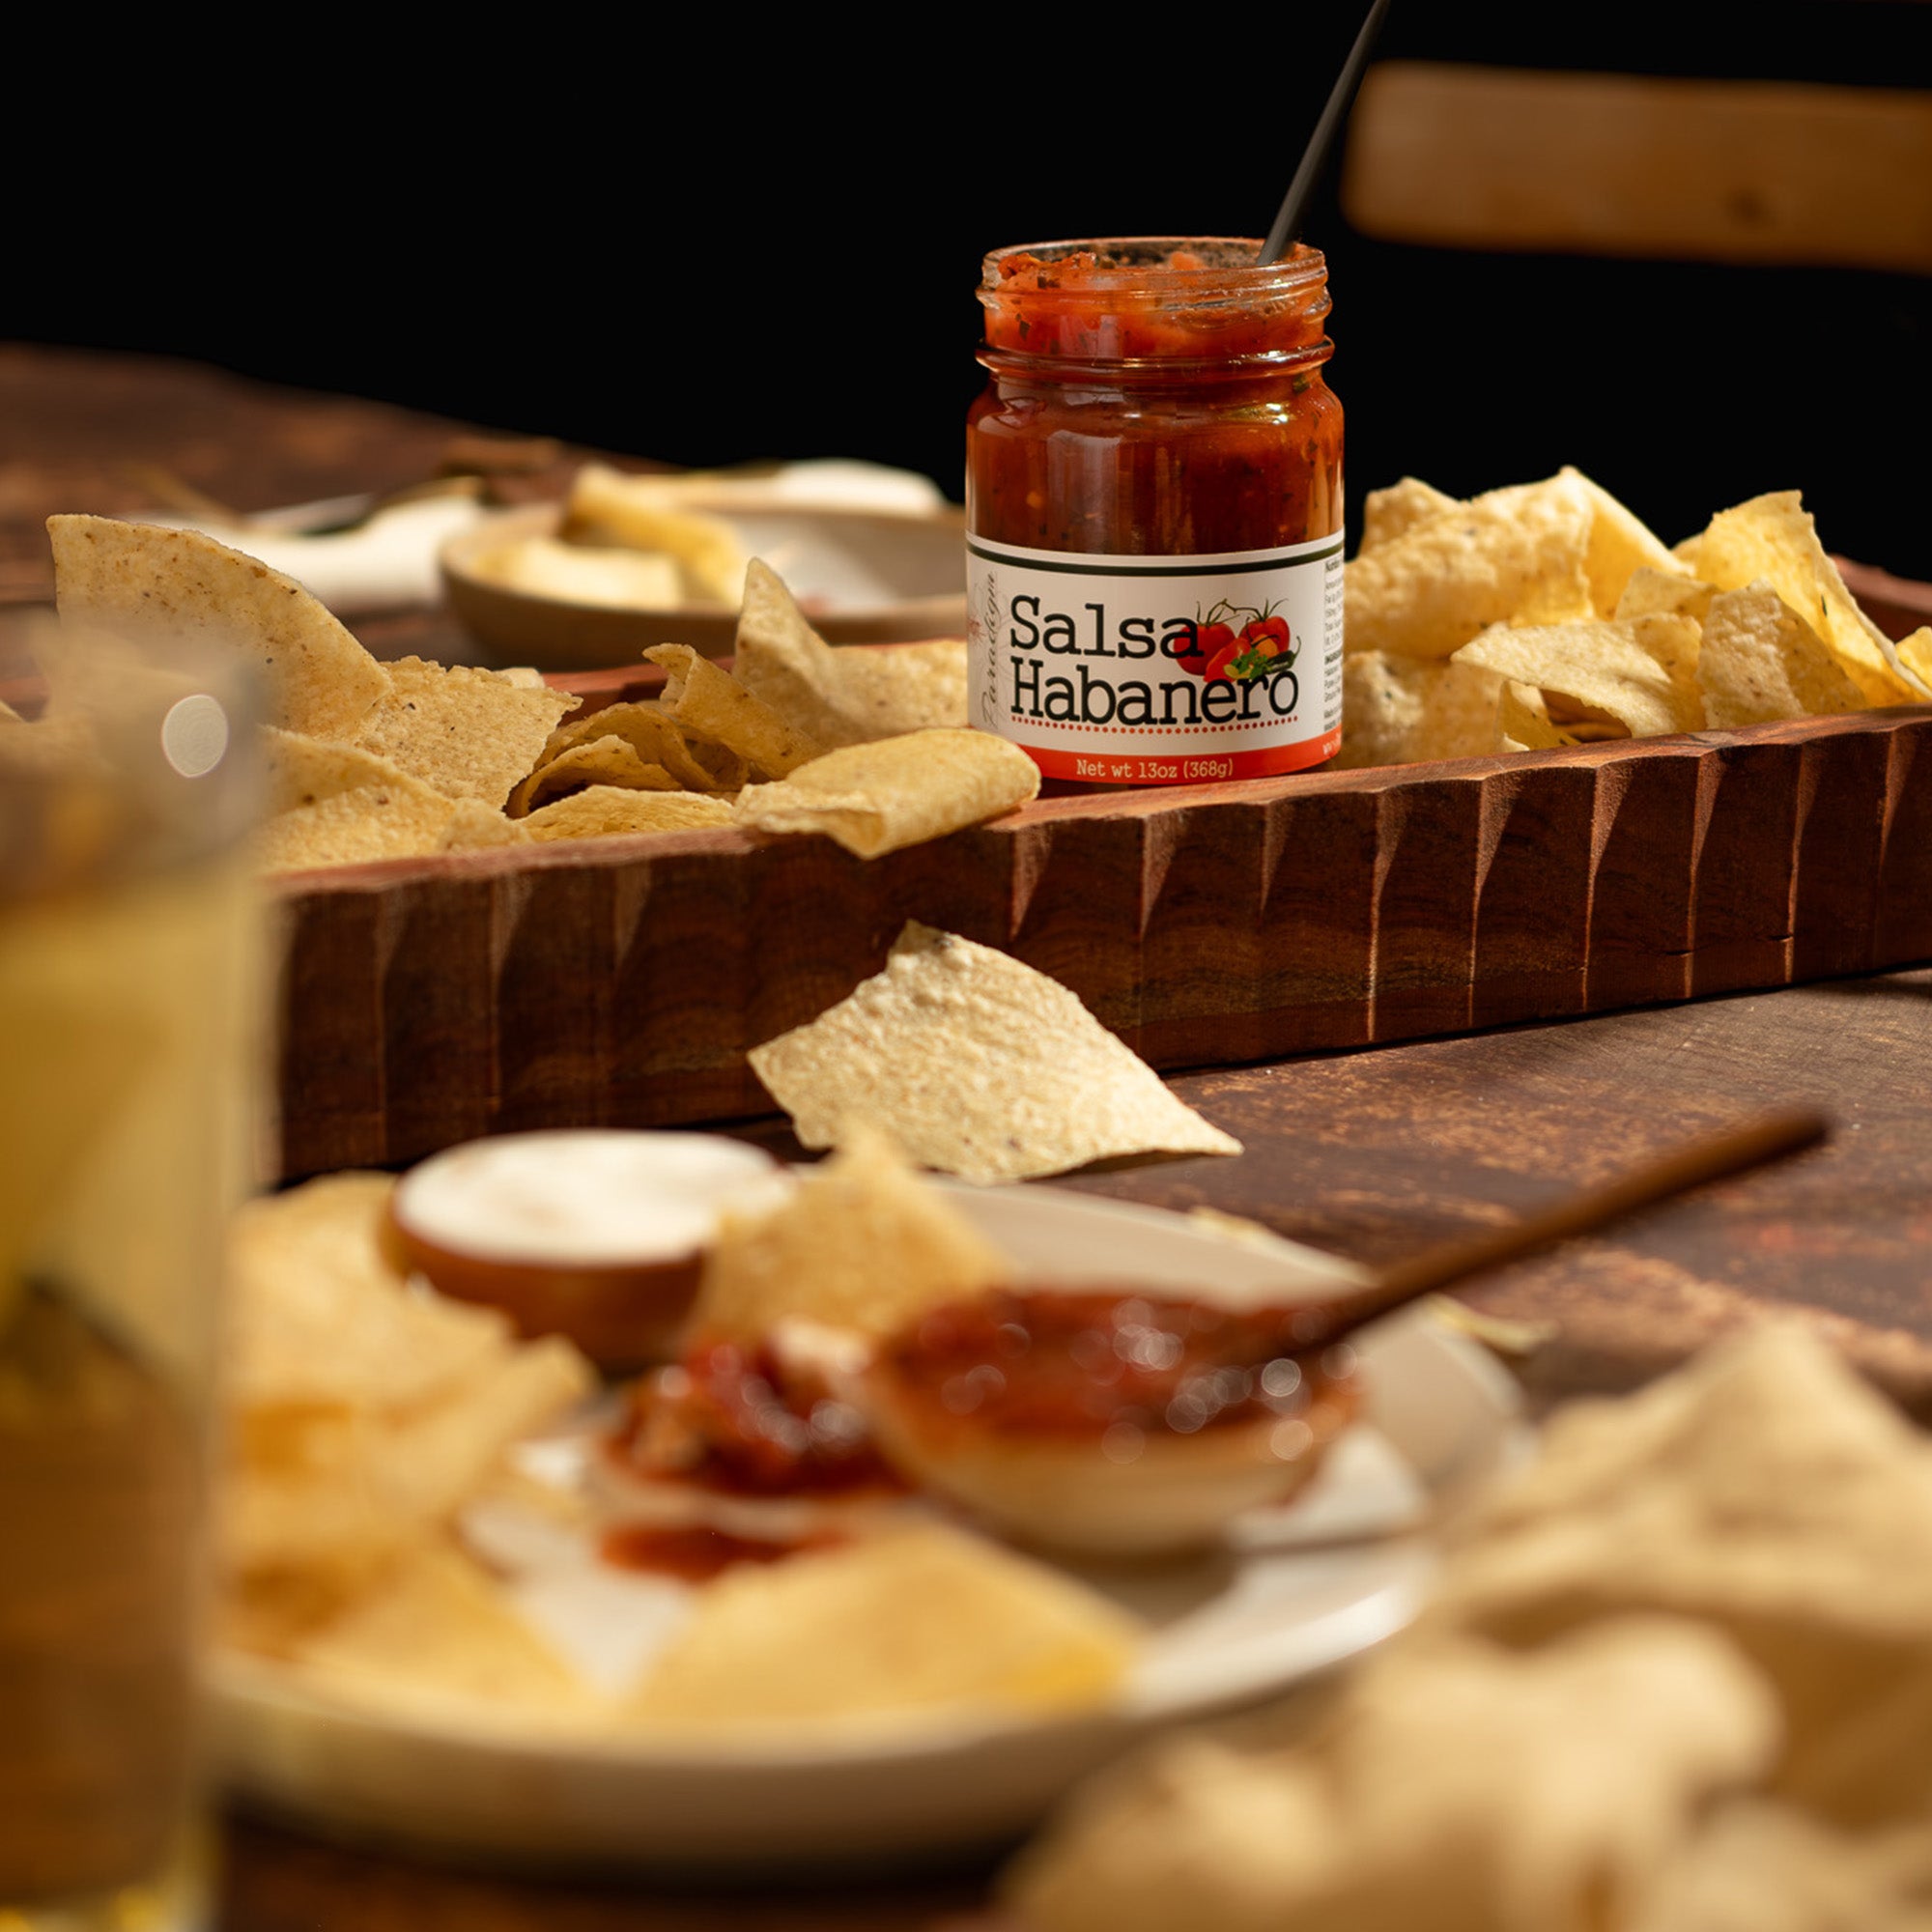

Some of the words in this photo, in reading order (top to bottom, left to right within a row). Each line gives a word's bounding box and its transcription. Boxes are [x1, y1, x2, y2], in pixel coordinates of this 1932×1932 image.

[1009, 594, 1206, 659] Salsa
[1009, 657, 1299, 725] Habanero
[1076, 758, 1106, 777] Net
[1112, 763, 1133, 778] wt
[1138, 761, 1178, 779] 13oz
[1182, 757, 1234, 780] (368g)
